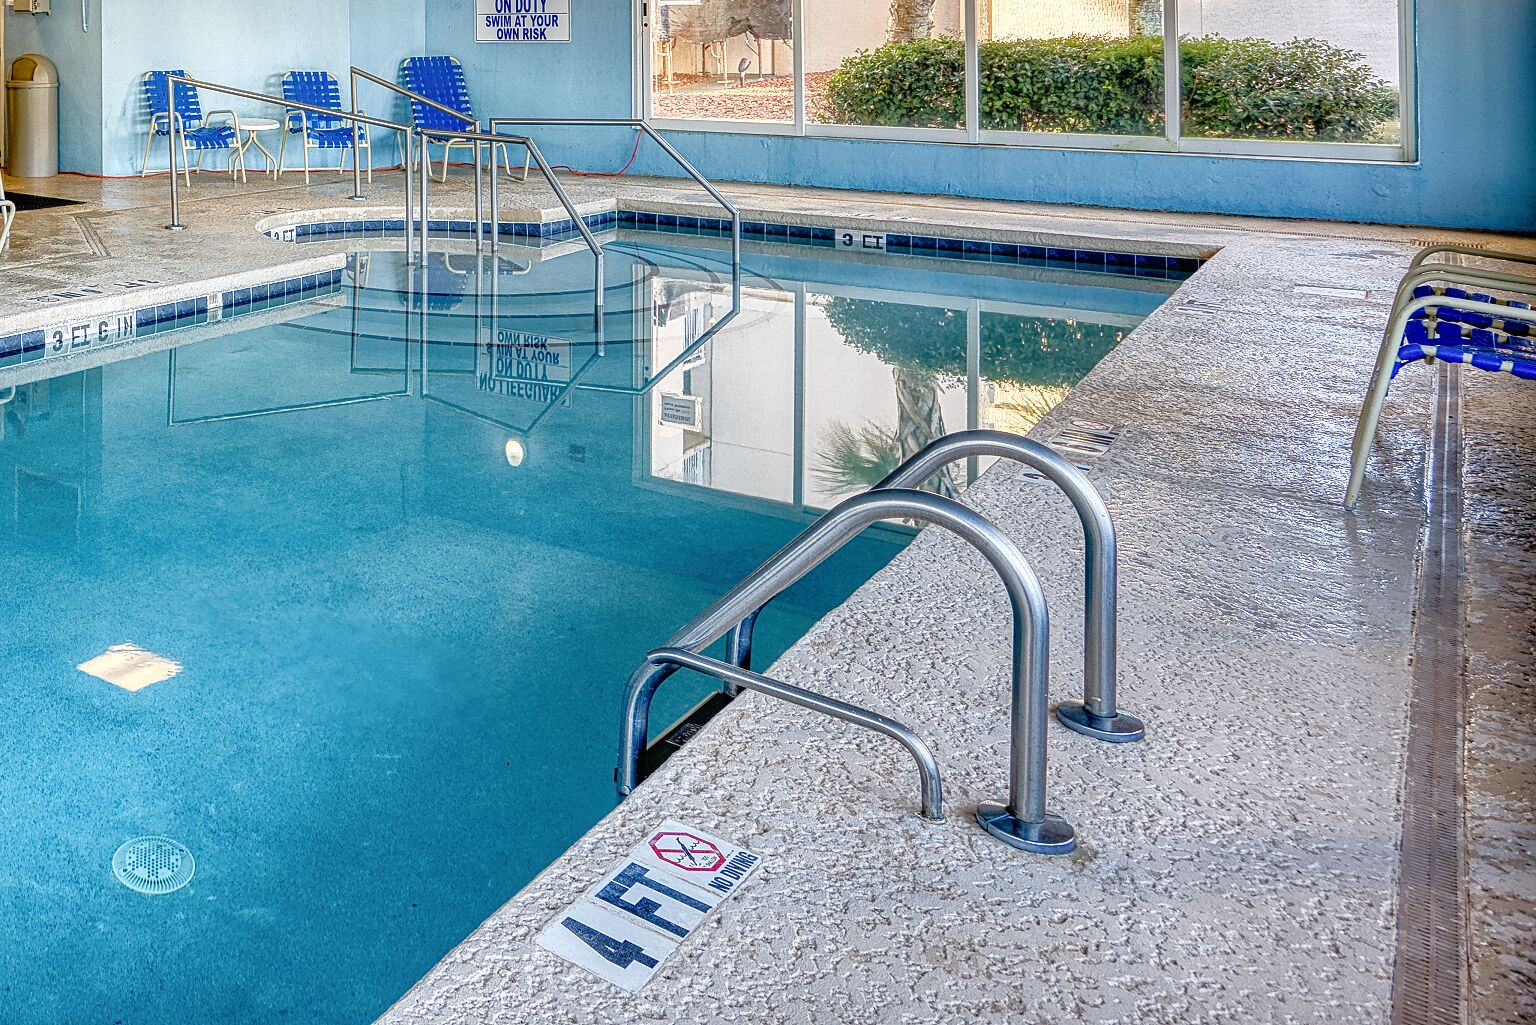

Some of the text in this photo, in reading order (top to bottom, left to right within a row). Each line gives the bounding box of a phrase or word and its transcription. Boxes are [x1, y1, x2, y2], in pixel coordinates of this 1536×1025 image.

[485, 15, 558, 27] SWIM AT YOUR
[496, 28, 547, 40] OWN RISK
[842, 233, 883, 249] 3 FT
[53, 330, 63, 352] 3
[71, 324, 91, 348] FT
[117, 315, 133, 338] IN
[708, 876, 732, 893] NO
[726, 851, 759, 886] DIVING
[561, 862, 713, 969] 4 FT
